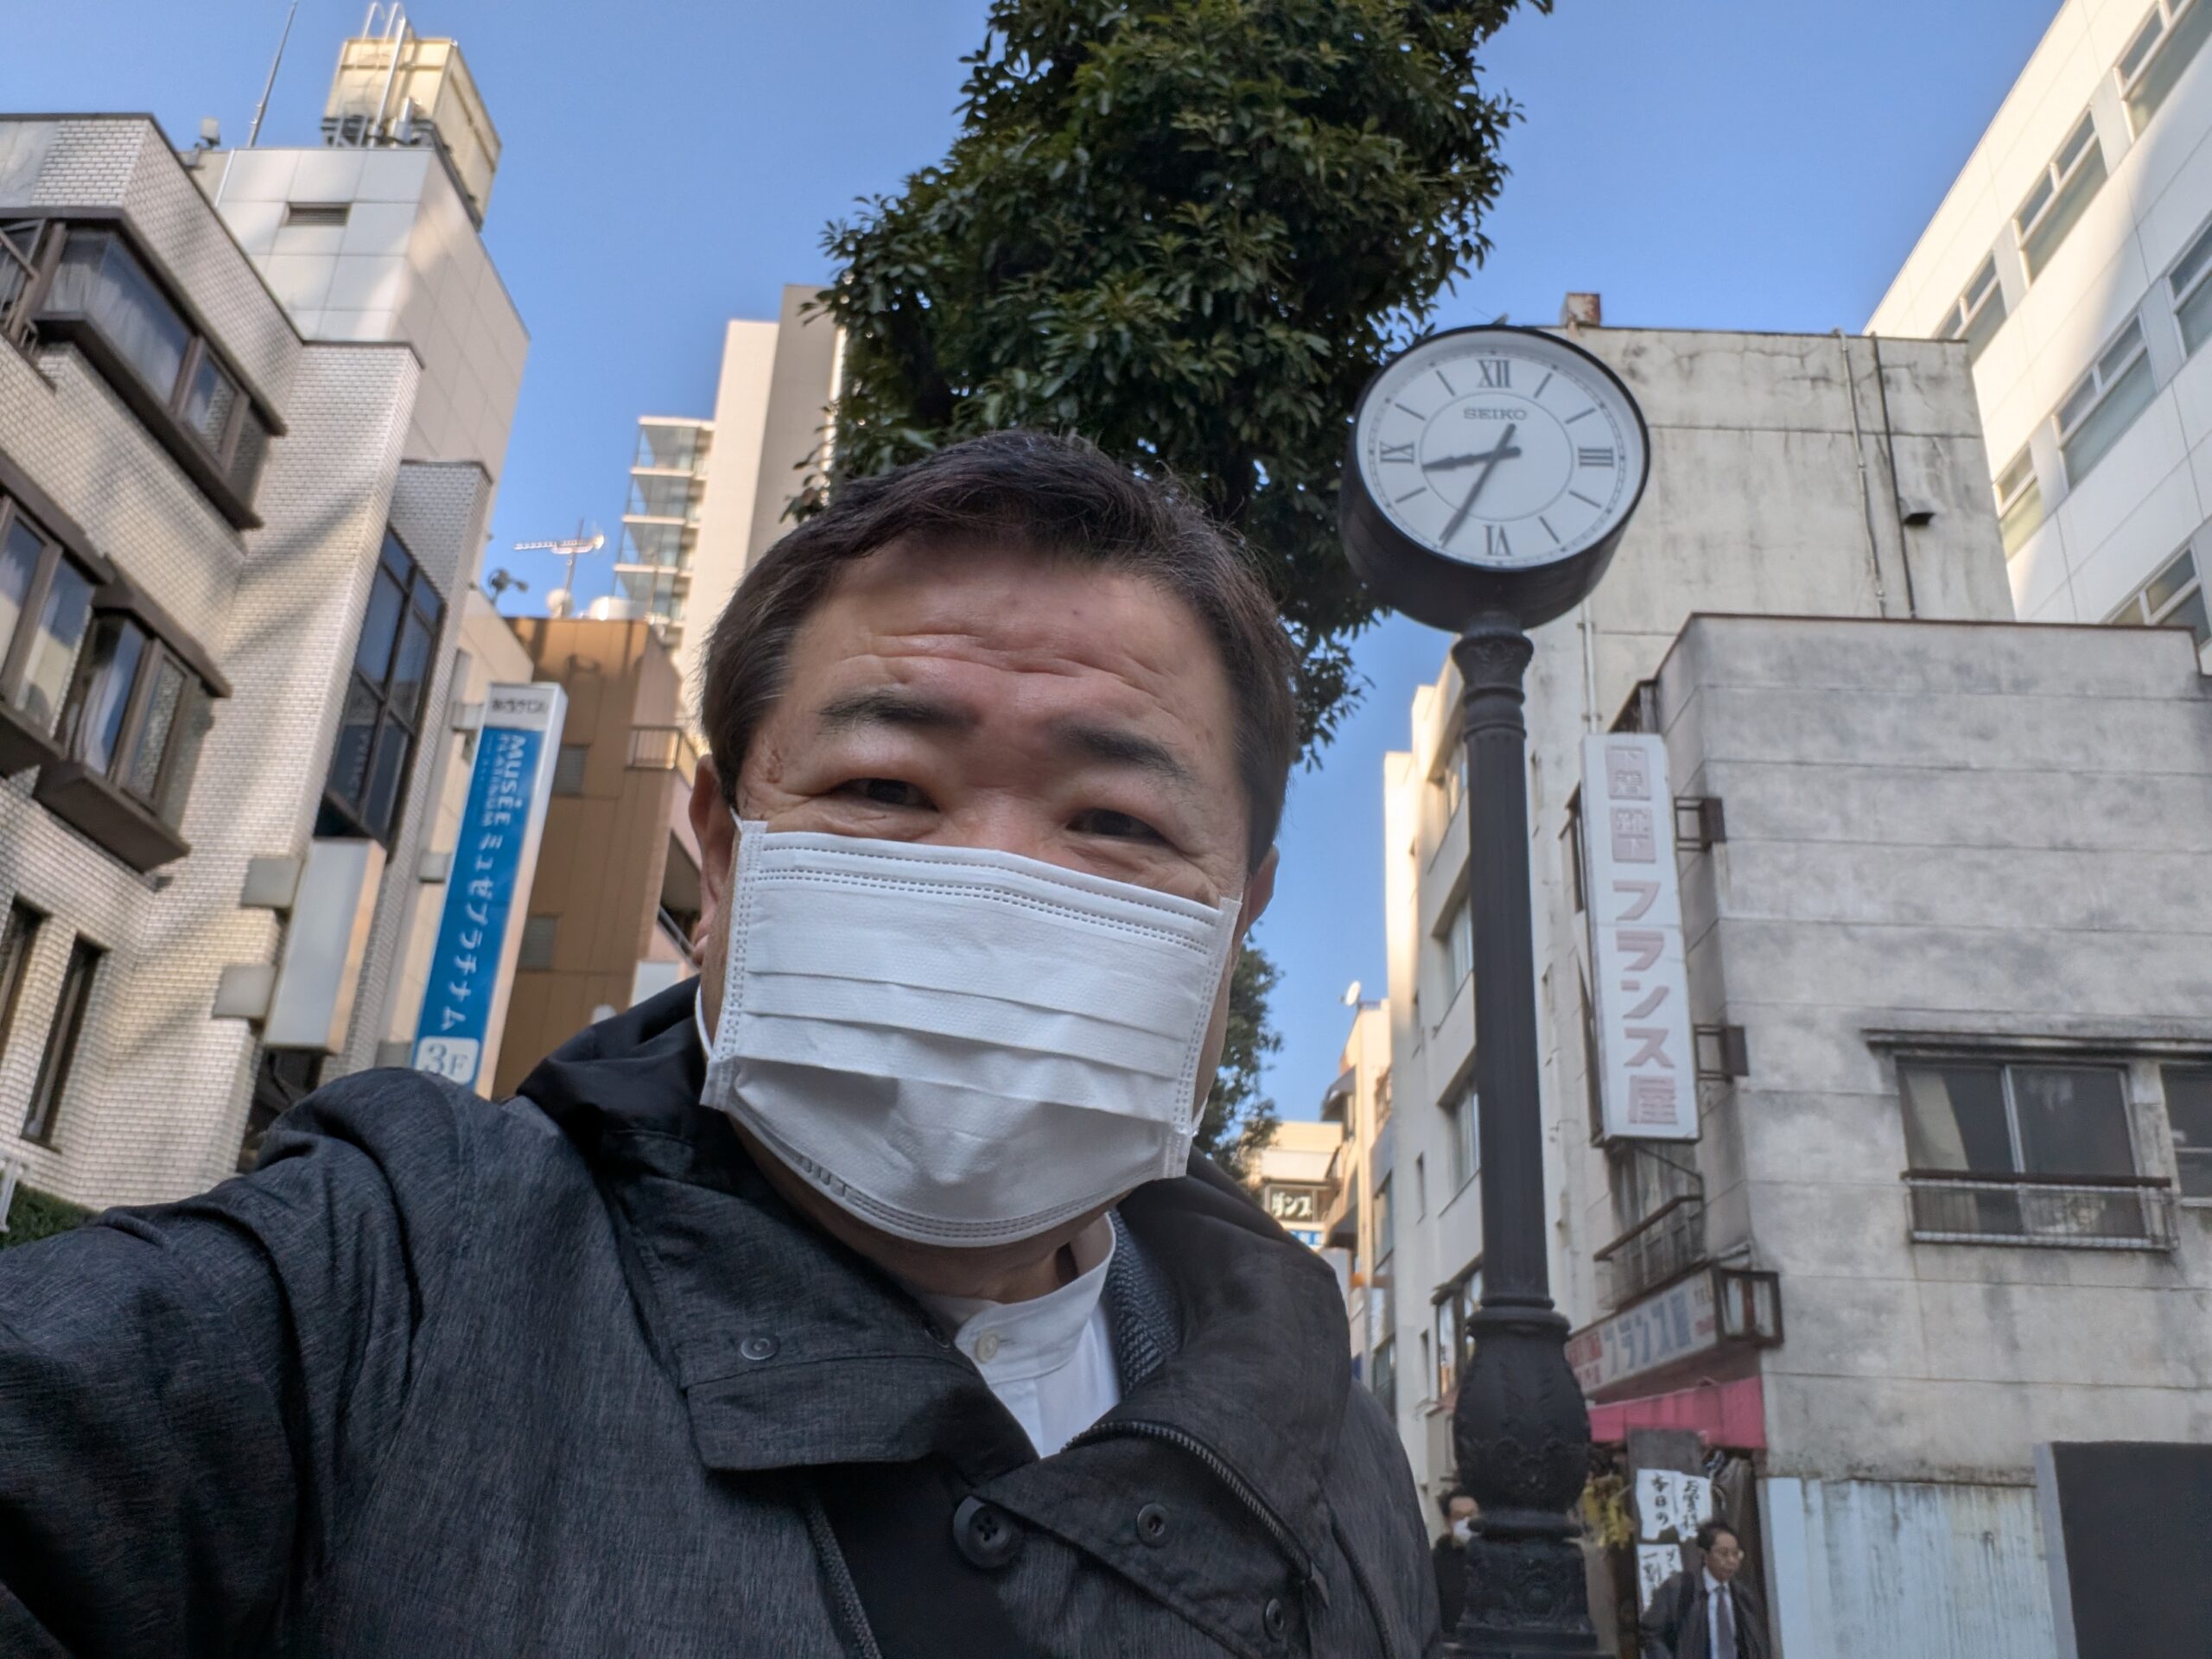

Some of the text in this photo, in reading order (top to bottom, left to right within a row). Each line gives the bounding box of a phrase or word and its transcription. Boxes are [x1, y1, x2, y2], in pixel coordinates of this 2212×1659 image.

[1478, 359, 1511, 388] XII
[1464, 409, 1528, 420] SEIKO
[1379, 442, 1414, 464] IX
[1578, 447, 1614, 468] III
[1484, 524, 1512, 556] VI
[439, 834, 504, 1031] ミュゼプラチナム
[1612, 880, 1679, 1125] フランス屋
[426, 1042, 469, 1075] 3F
